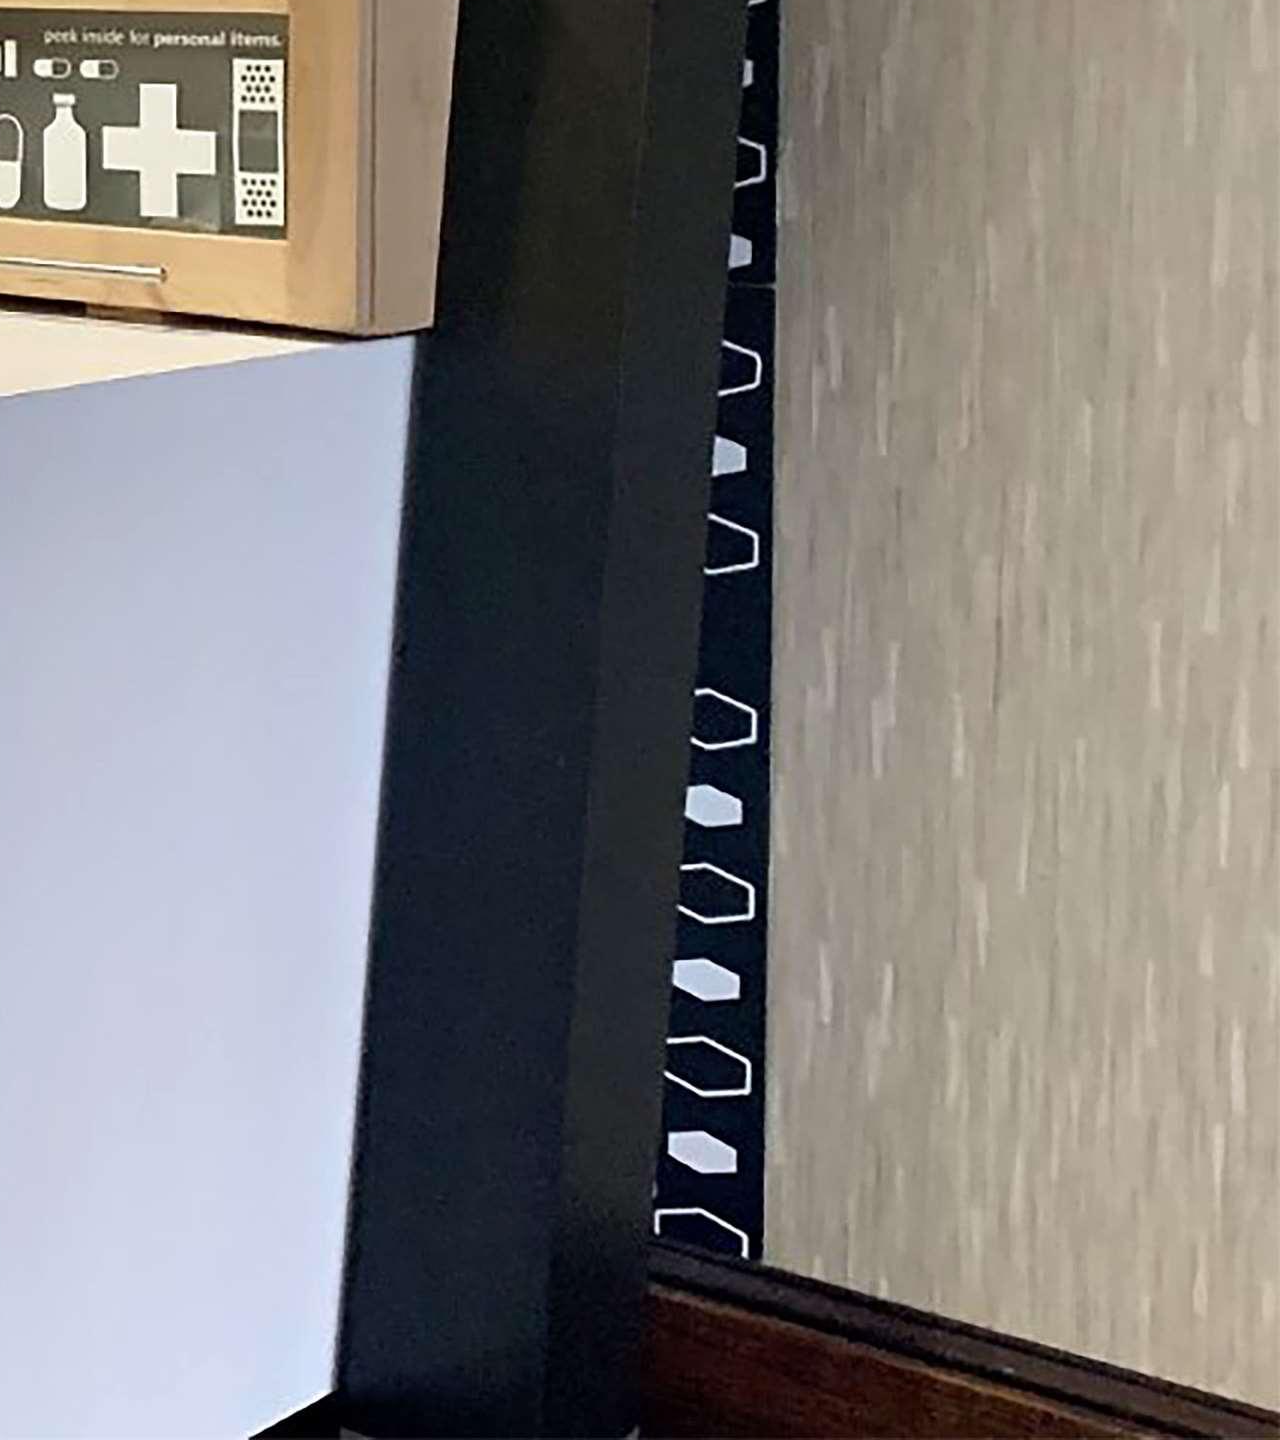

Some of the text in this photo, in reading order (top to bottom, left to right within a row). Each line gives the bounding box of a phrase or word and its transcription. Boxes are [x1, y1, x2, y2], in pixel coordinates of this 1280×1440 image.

[43, 28, 282, 48] peek inside for personal items.
